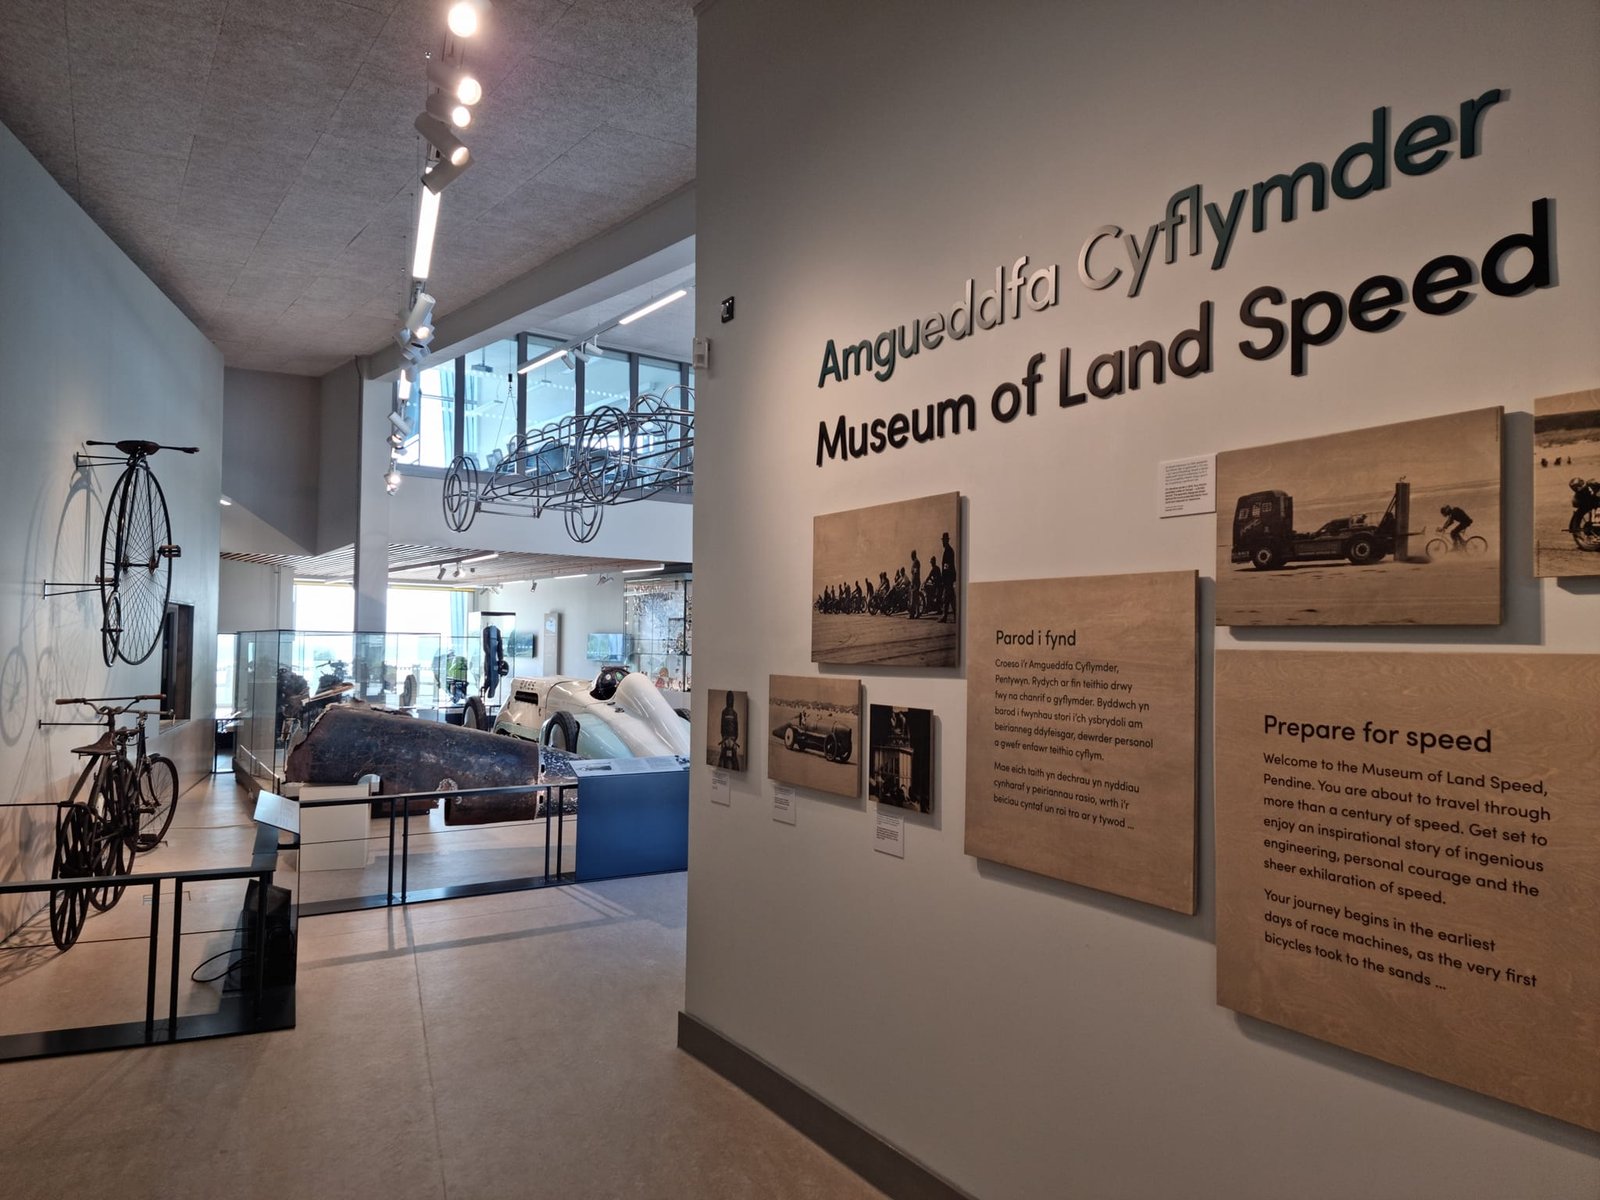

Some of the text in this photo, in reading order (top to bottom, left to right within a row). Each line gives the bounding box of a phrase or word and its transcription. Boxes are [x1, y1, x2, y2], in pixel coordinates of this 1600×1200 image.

[818, 88, 1507, 387] Amgueddfa Cyflymder
[815, 197, 1556, 466] Museum of Land Speed
[996, 629, 1076, 650] Parod i fynd
[995, 659, 1019, 668] Croeso
[1029, 660, 1073, 671] Amgueddfa
[1075, 661, 1119, 674] Cyflymder,
[995, 674, 1030, 686] Pentywyn.
[1032, 676, 1059, 688] Rydych
[1071, 678, 1081, 688] fin
[1083, 679, 1109, 690] teithio
[1110, 681, 1133, 694] drwy
[994, 706, 1143, 728] barod i fwynhau stori i'ch ysbrydoli am
[995, 690, 1007, 701] fwy
[1019, 692, 1046, 702] chanrif
[1053, 695, 1095, 706] gyflymder.
[1097, 697, 1136, 710] Byddwch
[1138, 703, 1150, 713] yn
[994, 722, 1153, 749] beirianneg ddyfeisgar, dewrder personol
[1001, 740, 1021, 750] gwefr
[1022, 742, 1048, 752] enfawr
[1049, 745, 1074, 757] teithio
[1075, 749, 1104, 761] cyflym.
[1264, 715, 1491, 754] Prepare for speed
[993, 779, 1130, 810] cynharaf y peiriannau rasio, wrth i'r
[994, 761, 1140, 793] Mae eich taith yn dechrau yn nyddiau
[1263, 752, 1548, 797] Welcome to the Museum of Land Speed,
[993, 793, 1019, 806] beiciau
[1020, 801, 1043, 811] cyntaf
[1044, 805, 1054, 813] un
[1056, 807, 1066, 816] roi
[1068, 808, 1080, 818] tro
[1081, 812, 1090, 820] ar
[1092, 815, 1097, 824] y
[1099, 814, 1125, 828] tywod
[1264, 773, 1551, 823] Pendine. You are about to travel through
[1264, 797, 1548, 846] more than a century of speed. Get set to
[1264, 817, 1544, 872] enjoy an inspirational story of ingenious
[1264, 839, 1539, 897] engineering, personal courage and the
[1264, 857, 1446, 904] sheer exhilaration of speed.
[1264, 888, 1496, 952] Your journey begins in the earliest
[1264, 910, 1537, 987] days of race machines, as the very first
[1265, 931, 1312, 954] bicycles
[1315, 945, 1342, 962] took
[1345, 953, 1359, 966] to
[1362, 957, 1385, 973] the
[1388, 967, 1431, 986] sands
